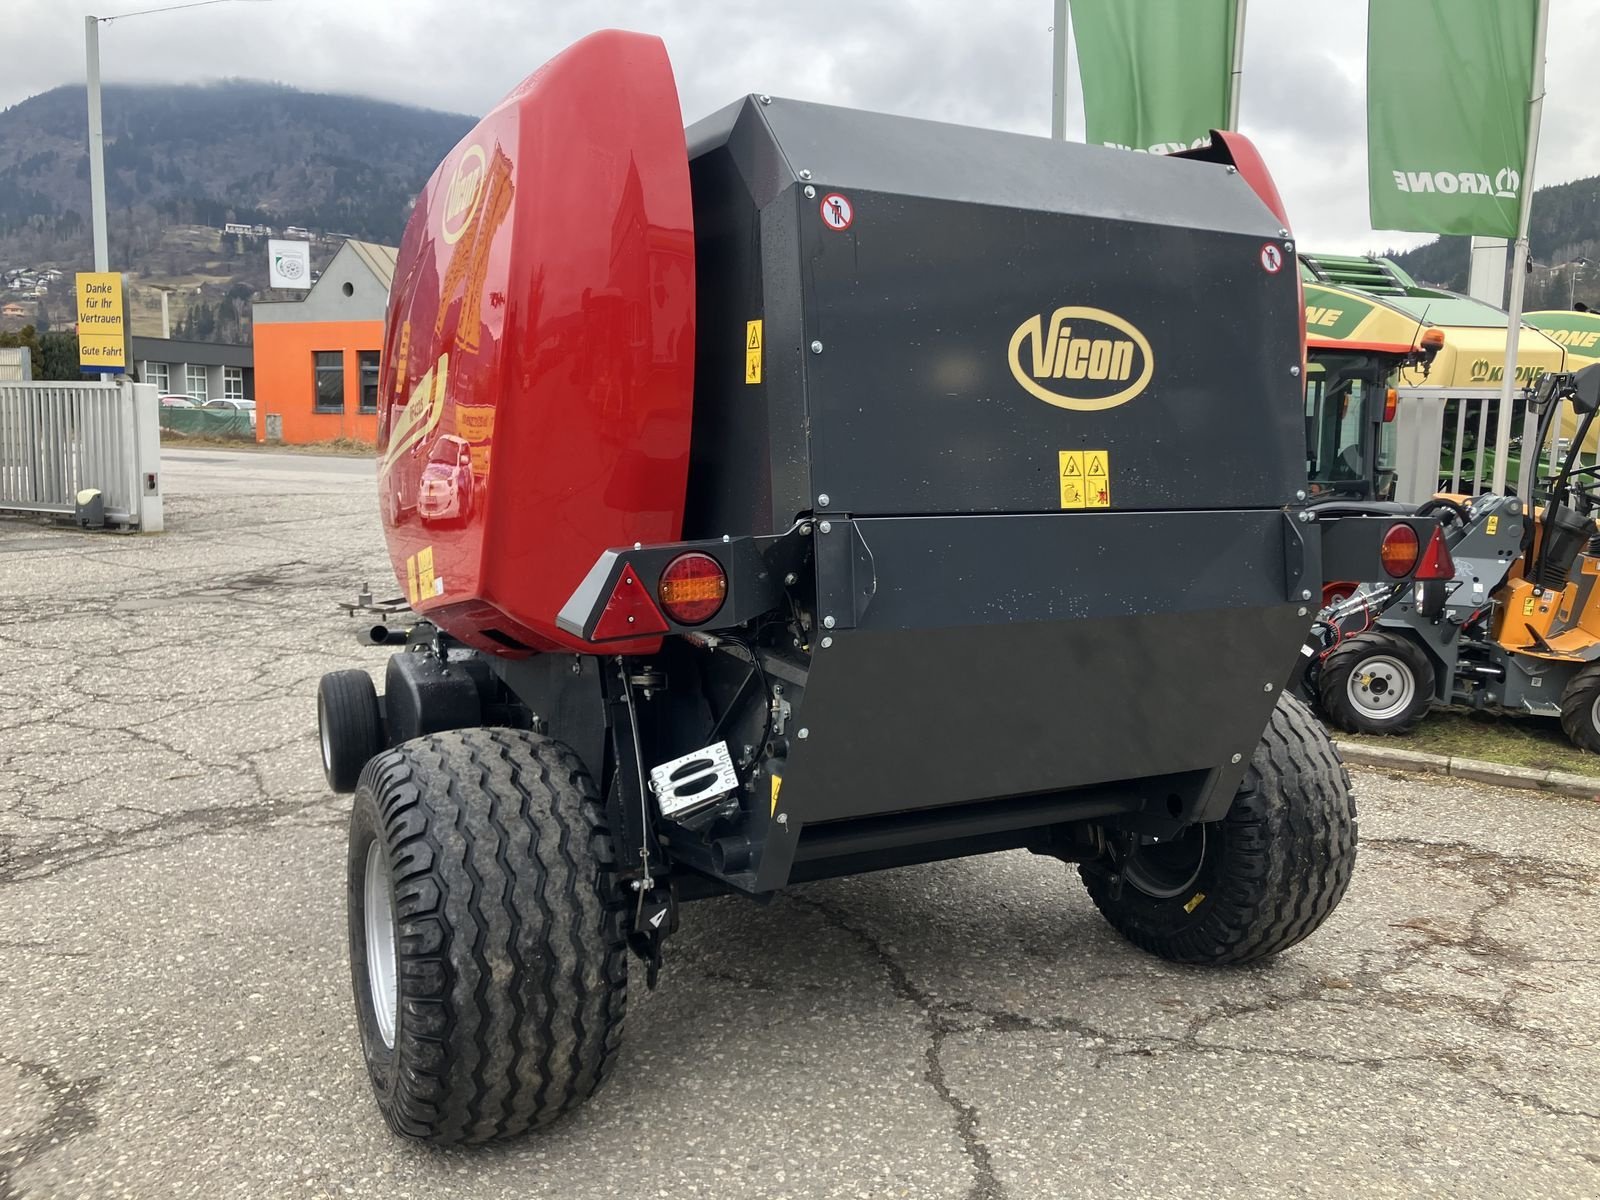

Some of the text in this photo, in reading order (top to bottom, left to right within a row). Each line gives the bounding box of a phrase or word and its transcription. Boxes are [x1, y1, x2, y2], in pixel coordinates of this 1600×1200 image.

[86, 283, 112, 294] Danke
[86, 298, 112, 308] für Ihr
[80, 313, 121, 323] Vertrauen
[81, 346, 122, 356] Gute Fahrt
[1487, 366, 1544, 381] KONE
